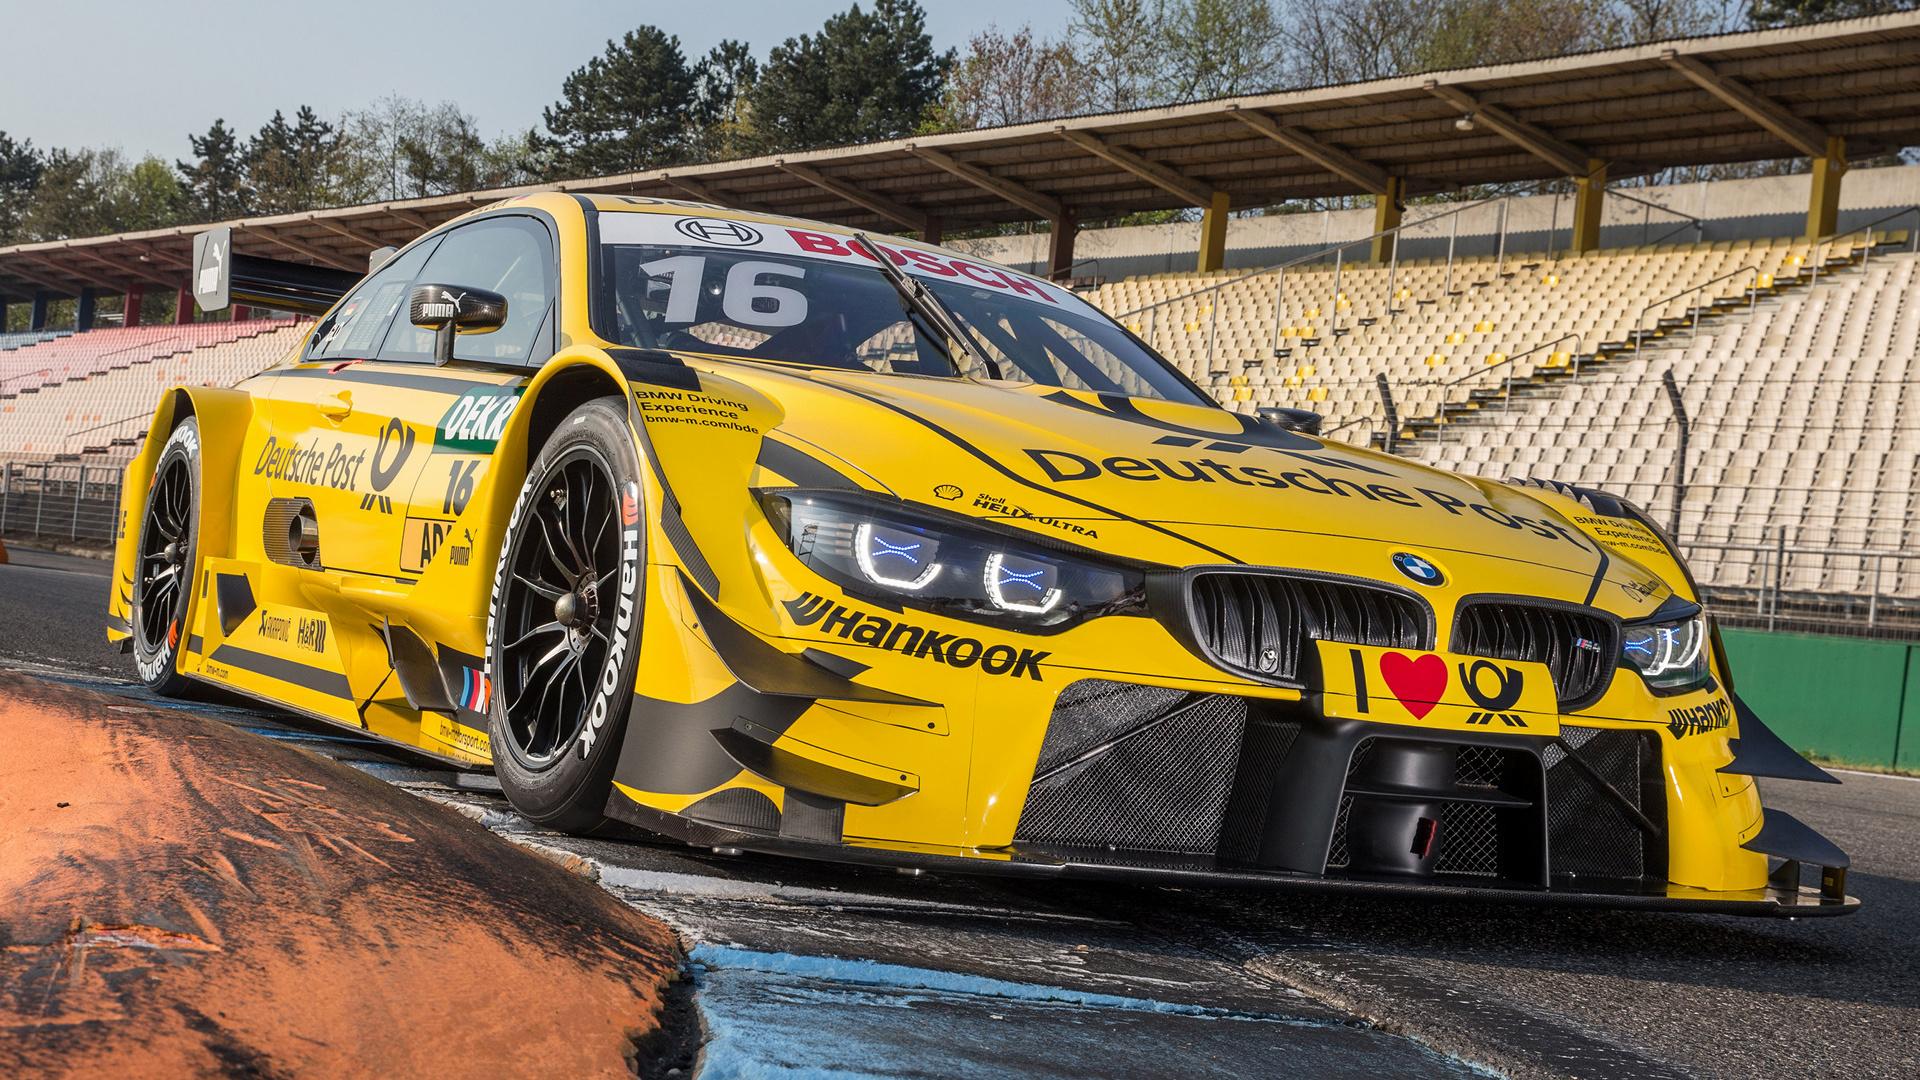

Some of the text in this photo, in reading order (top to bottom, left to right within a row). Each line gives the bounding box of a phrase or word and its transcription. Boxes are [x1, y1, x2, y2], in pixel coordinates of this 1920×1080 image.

[787, 229, 1059, 304] BOSCH
[639, 255, 809, 327] 16
[422, 303, 454, 318] PUMA
[634, 391, 749, 411] BMW Driving
[640, 401, 738, 420] Experience
[645, 415, 759, 434] bmw-m.com/bde
[254, 436, 367, 492] Deutsche Post
[443, 460, 480, 517] 16
[978, 493, 1006, 504] Shell
[1023, 448, 1592, 553] Deutsche Post
[420, 522, 452, 568] AD
[1038, 517, 1098, 539] ULTRA
[449, 545, 470, 566] PUMA
[1349, 648, 1370, 714] I
